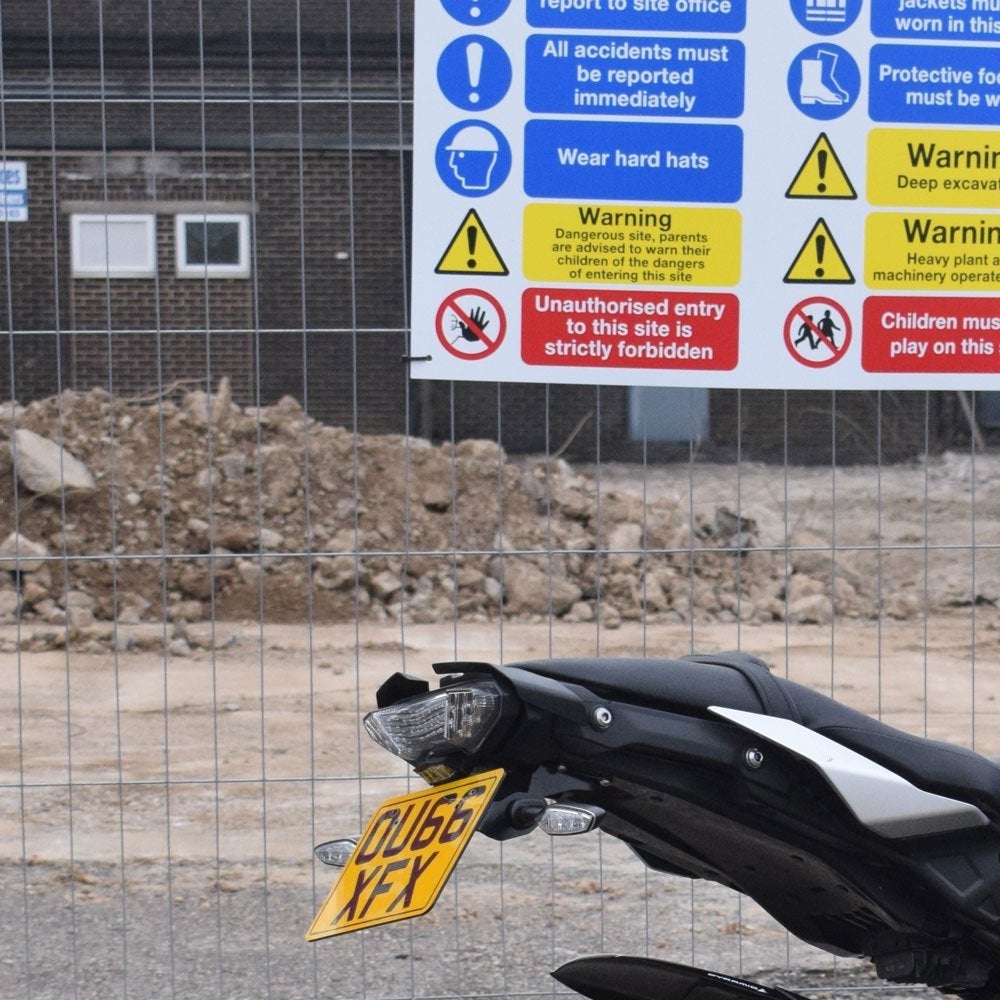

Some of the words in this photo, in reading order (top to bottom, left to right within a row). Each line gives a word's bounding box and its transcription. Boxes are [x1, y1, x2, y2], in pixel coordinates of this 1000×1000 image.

[895, 18, 942, 31] worn
[948, 16, 964, 32] in
[543, 40, 568, 57] All
[575, 42, 672, 60] accidents
[678, 46, 728, 61] must
[577, 65, 601, 82] be
[608, 68, 693, 86] reported
[880, 64, 973, 84] Protective
[575, 89, 696, 112] immediately
[906, 90, 952, 105] must
[958, 90, 980, 106] be
[558, 148, 610, 165] Wear
[616, 150, 660, 167] hard
[667, 151, 709, 169] hats
[898, 175, 937, 192] Deep
[579, 207, 671, 231] Warning
[556, 228, 624, 242] Dangerous
[629, 232, 655, 242] site,
[660, 233, 707, 243] parents
[552, 244, 572, 252] are
[576, 243, 625, 253] advised
[630, 244, 641, 254] to
[682, 245, 710, 255] their
[558, 255, 608, 266] children
[613, 257, 624, 266] of
[629, 257, 649, 268] the
[653, 258, 704, 270] dangers
[908, 253, 949, 267] Heavy
[954, 254, 988, 267] plant
[570, 269, 582, 278] of
[586, 270, 638, 282] entering
[643, 271, 665, 281] this
[670, 272, 692, 281] site
[874, 269, 946, 284] machinery
[535, 295, 668, 315] Unauthorised
[674, 301, 725, 320] entry
[566, 319, 586, 334] to
[592, 319, 628, 336] this
[634, 320, 670, 337] site
[676, 321, 692, 337] is
[881, 312, 957, 329] Children
[545, 340, 612, 360] strictly
[618, 341, 713, 359] forbidden
[891, 338, 928, 357] play
[933, 342, 955, 354] on
[961, 339, 994, 354] this
[354, 785, 487, 866] OU66
[330, 851, 440, 926] XFX
